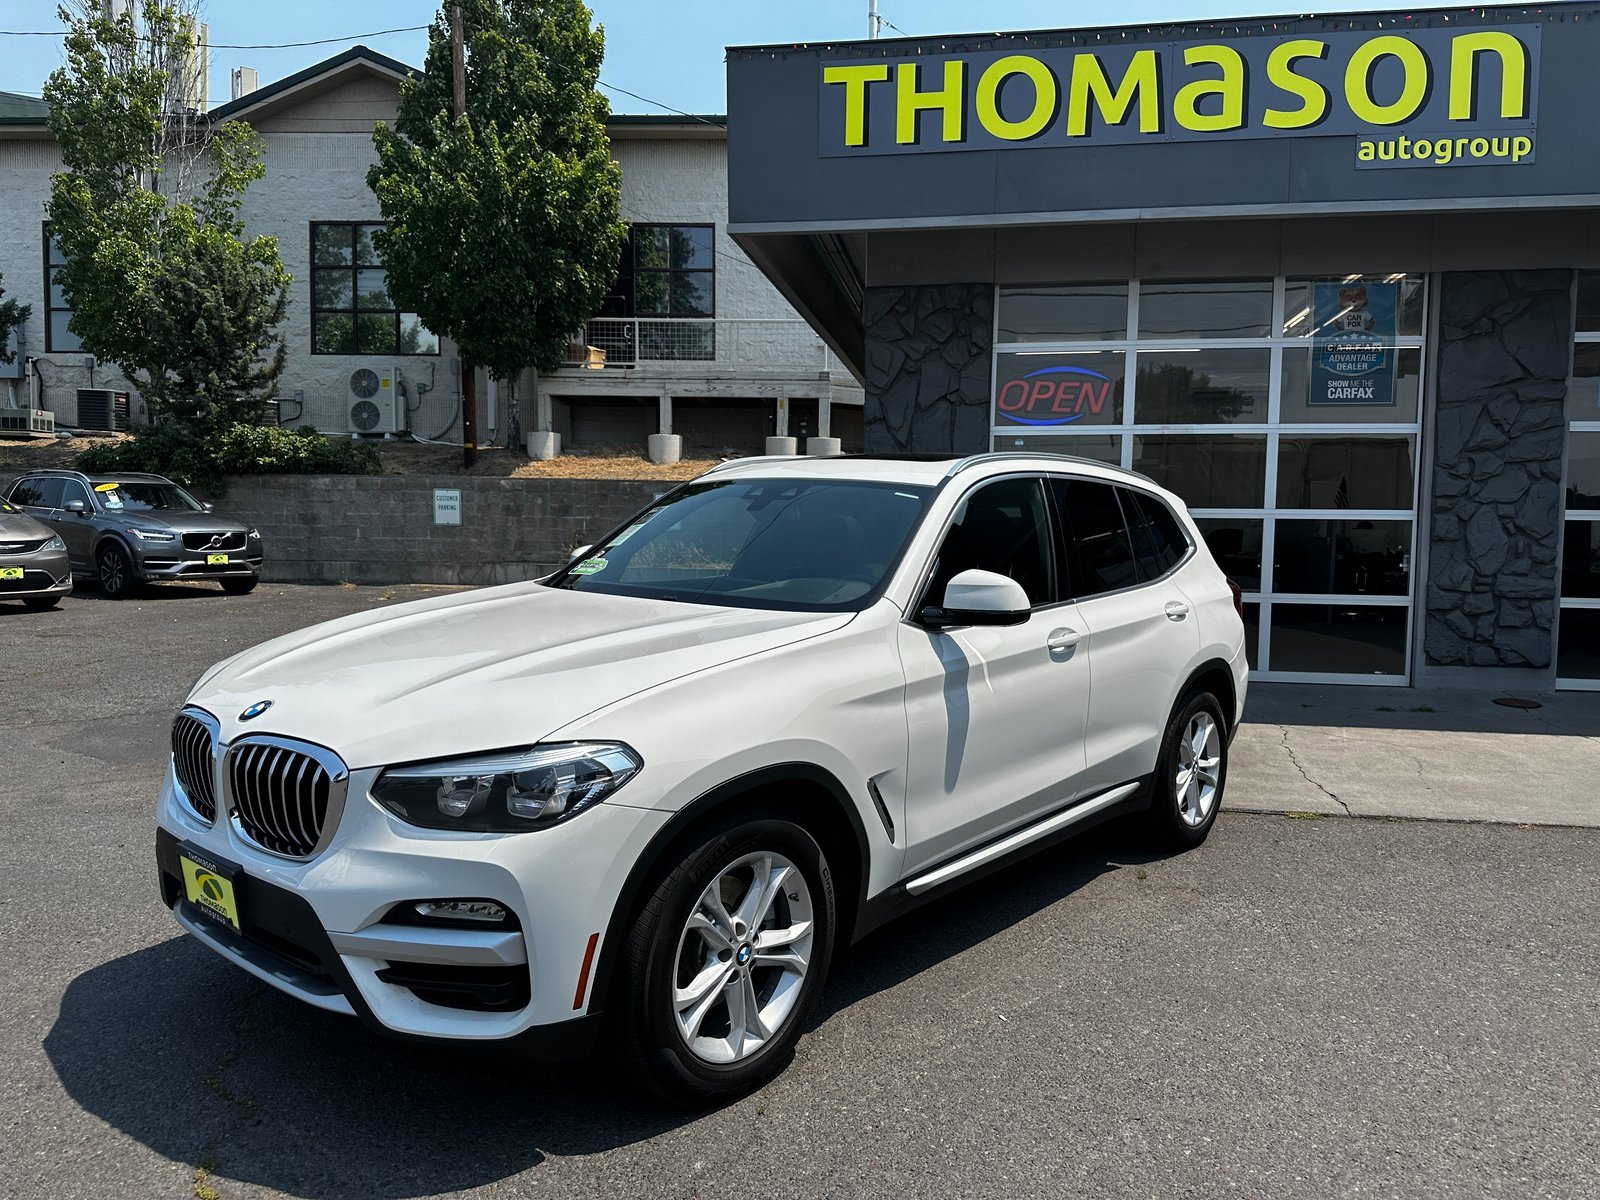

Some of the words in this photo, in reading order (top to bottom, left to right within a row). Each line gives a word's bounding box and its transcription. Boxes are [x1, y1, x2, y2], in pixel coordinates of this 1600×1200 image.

[1358, 136, 1532, 163] autogroup
[1346, 313, 1362, 321] CAR
[1328, 353, 1377, 362] ADVANTAGE
[1336, 362, 1368, 371] DEALER
[1327, 380, 1349, 388] SHOW
[1362, 379, 1374, 387] THE
[998, 380, 1111, 414] OPEN
[1327, 387, 1374, 399] CARFAX
